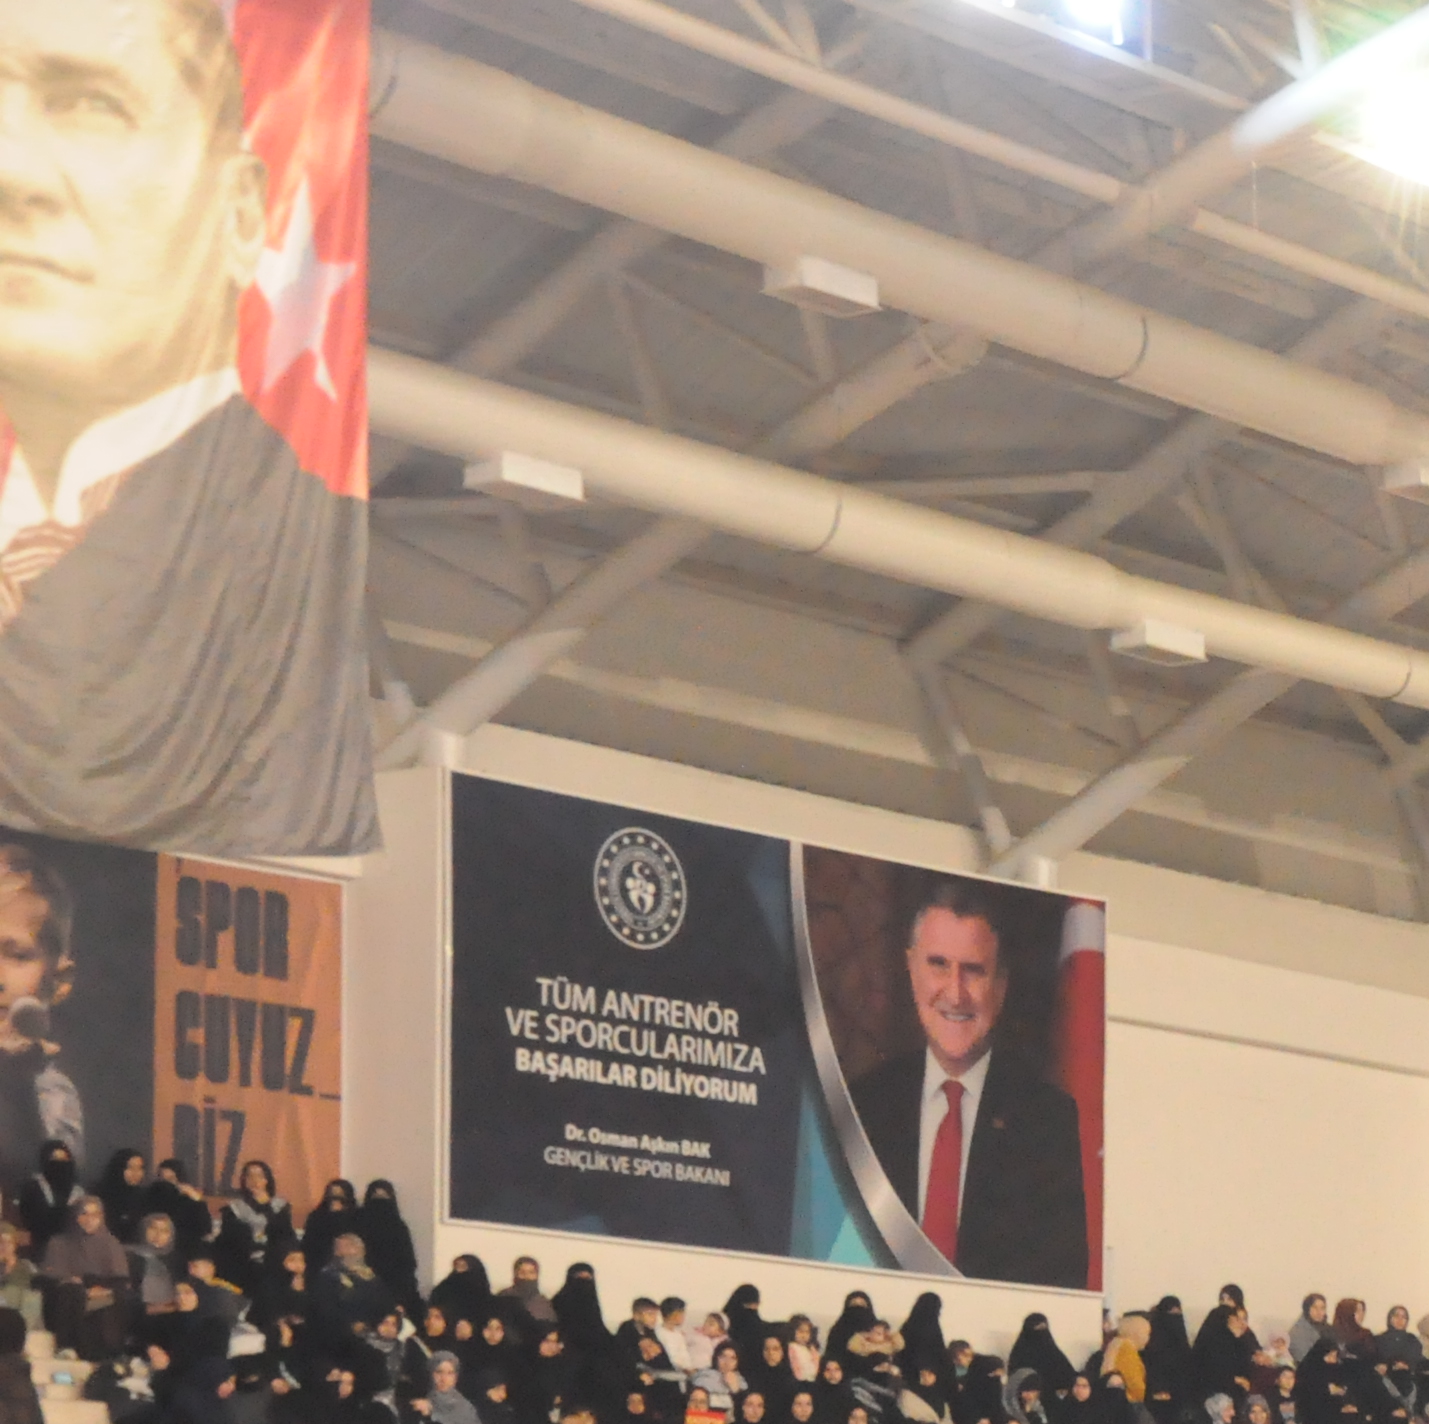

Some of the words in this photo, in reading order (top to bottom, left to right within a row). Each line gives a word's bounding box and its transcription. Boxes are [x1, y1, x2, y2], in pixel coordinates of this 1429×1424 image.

[175, 876, 290, 981] SPOR
[535, 975, 596, 1015] TÜM
[602, 989, 739, 1037] ANTRENÖR
[505, 1006, 540, 1041] VE
[545, 1013, 767, 1075] SPORCULARIMIZA
[514, 1046, 638, 1089] BAŞARILAR
[640, 1064, 758, 1106] DİLİYORUM
[543, 1146, 610, 1172] GENÇLİK
[611, 1156, 631, 1175] VE
[633, 1157, 673, 1179] SPOR
[675, 1163, 731, 1187] BAKANI
[564, 1122, 587, 1142] Dr.
[588, 1126, 639, 1150] Osman
[681, 1138, 712, 1159] BAK
